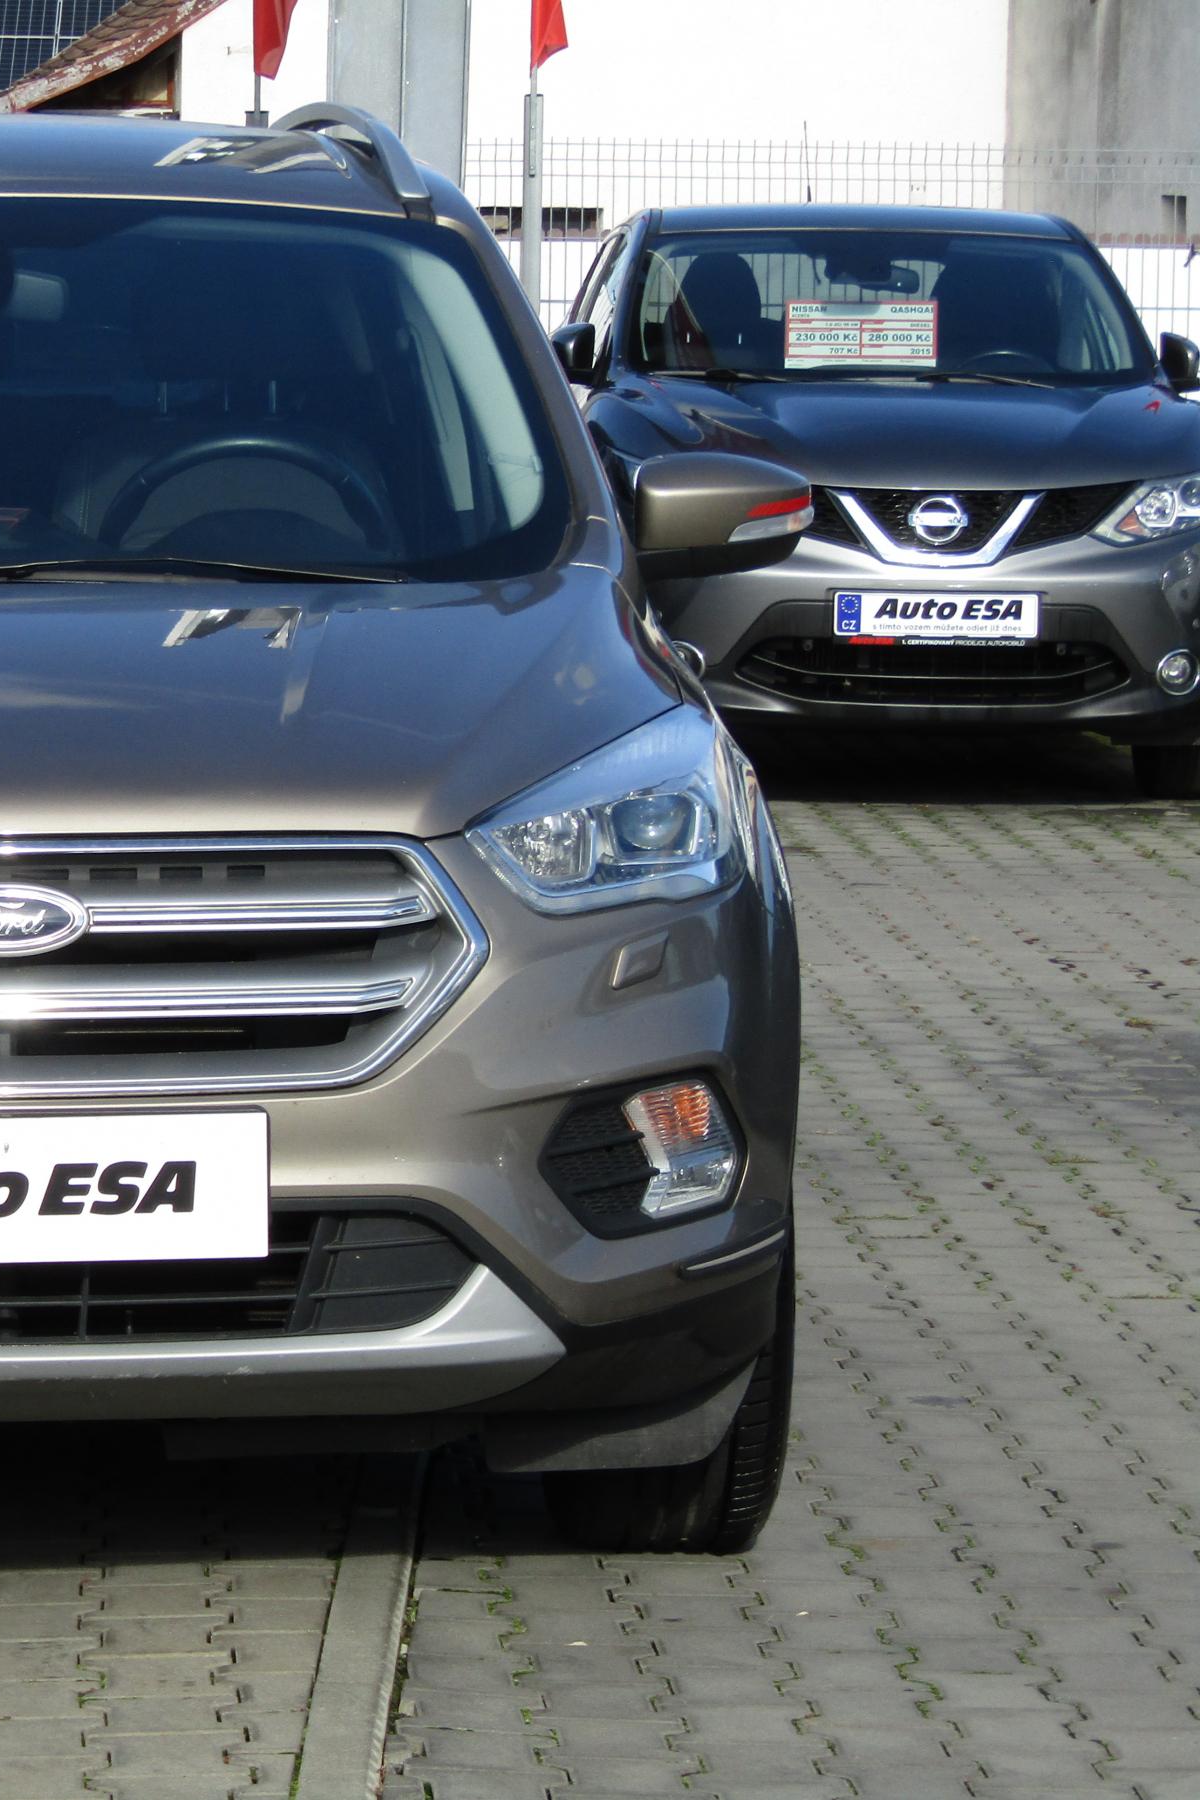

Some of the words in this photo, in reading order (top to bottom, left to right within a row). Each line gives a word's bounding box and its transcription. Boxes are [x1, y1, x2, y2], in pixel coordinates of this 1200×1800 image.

[795, 333, 816, 342] 230
[819, 333, 840, 342] 000
[843, 333, 858, 342] Kč
[868, 333, 889, 342] 280
[892, 333, 912, 342] 000
[916, 333, 931, 342] Kč
[874, 598, 958, 620] Auto
[961, 599, 1023, 621] ESA
[841, 620, 857, 630] CZ
[966, 624, 988, 633] odjet
[989, 624, 1000, 633] již
[1002, 624, 1022, 632] dnes
[907, 639, 955, 647] CERTIFIKOVANÝ
[37, 1160, 197, 1216] ESA
